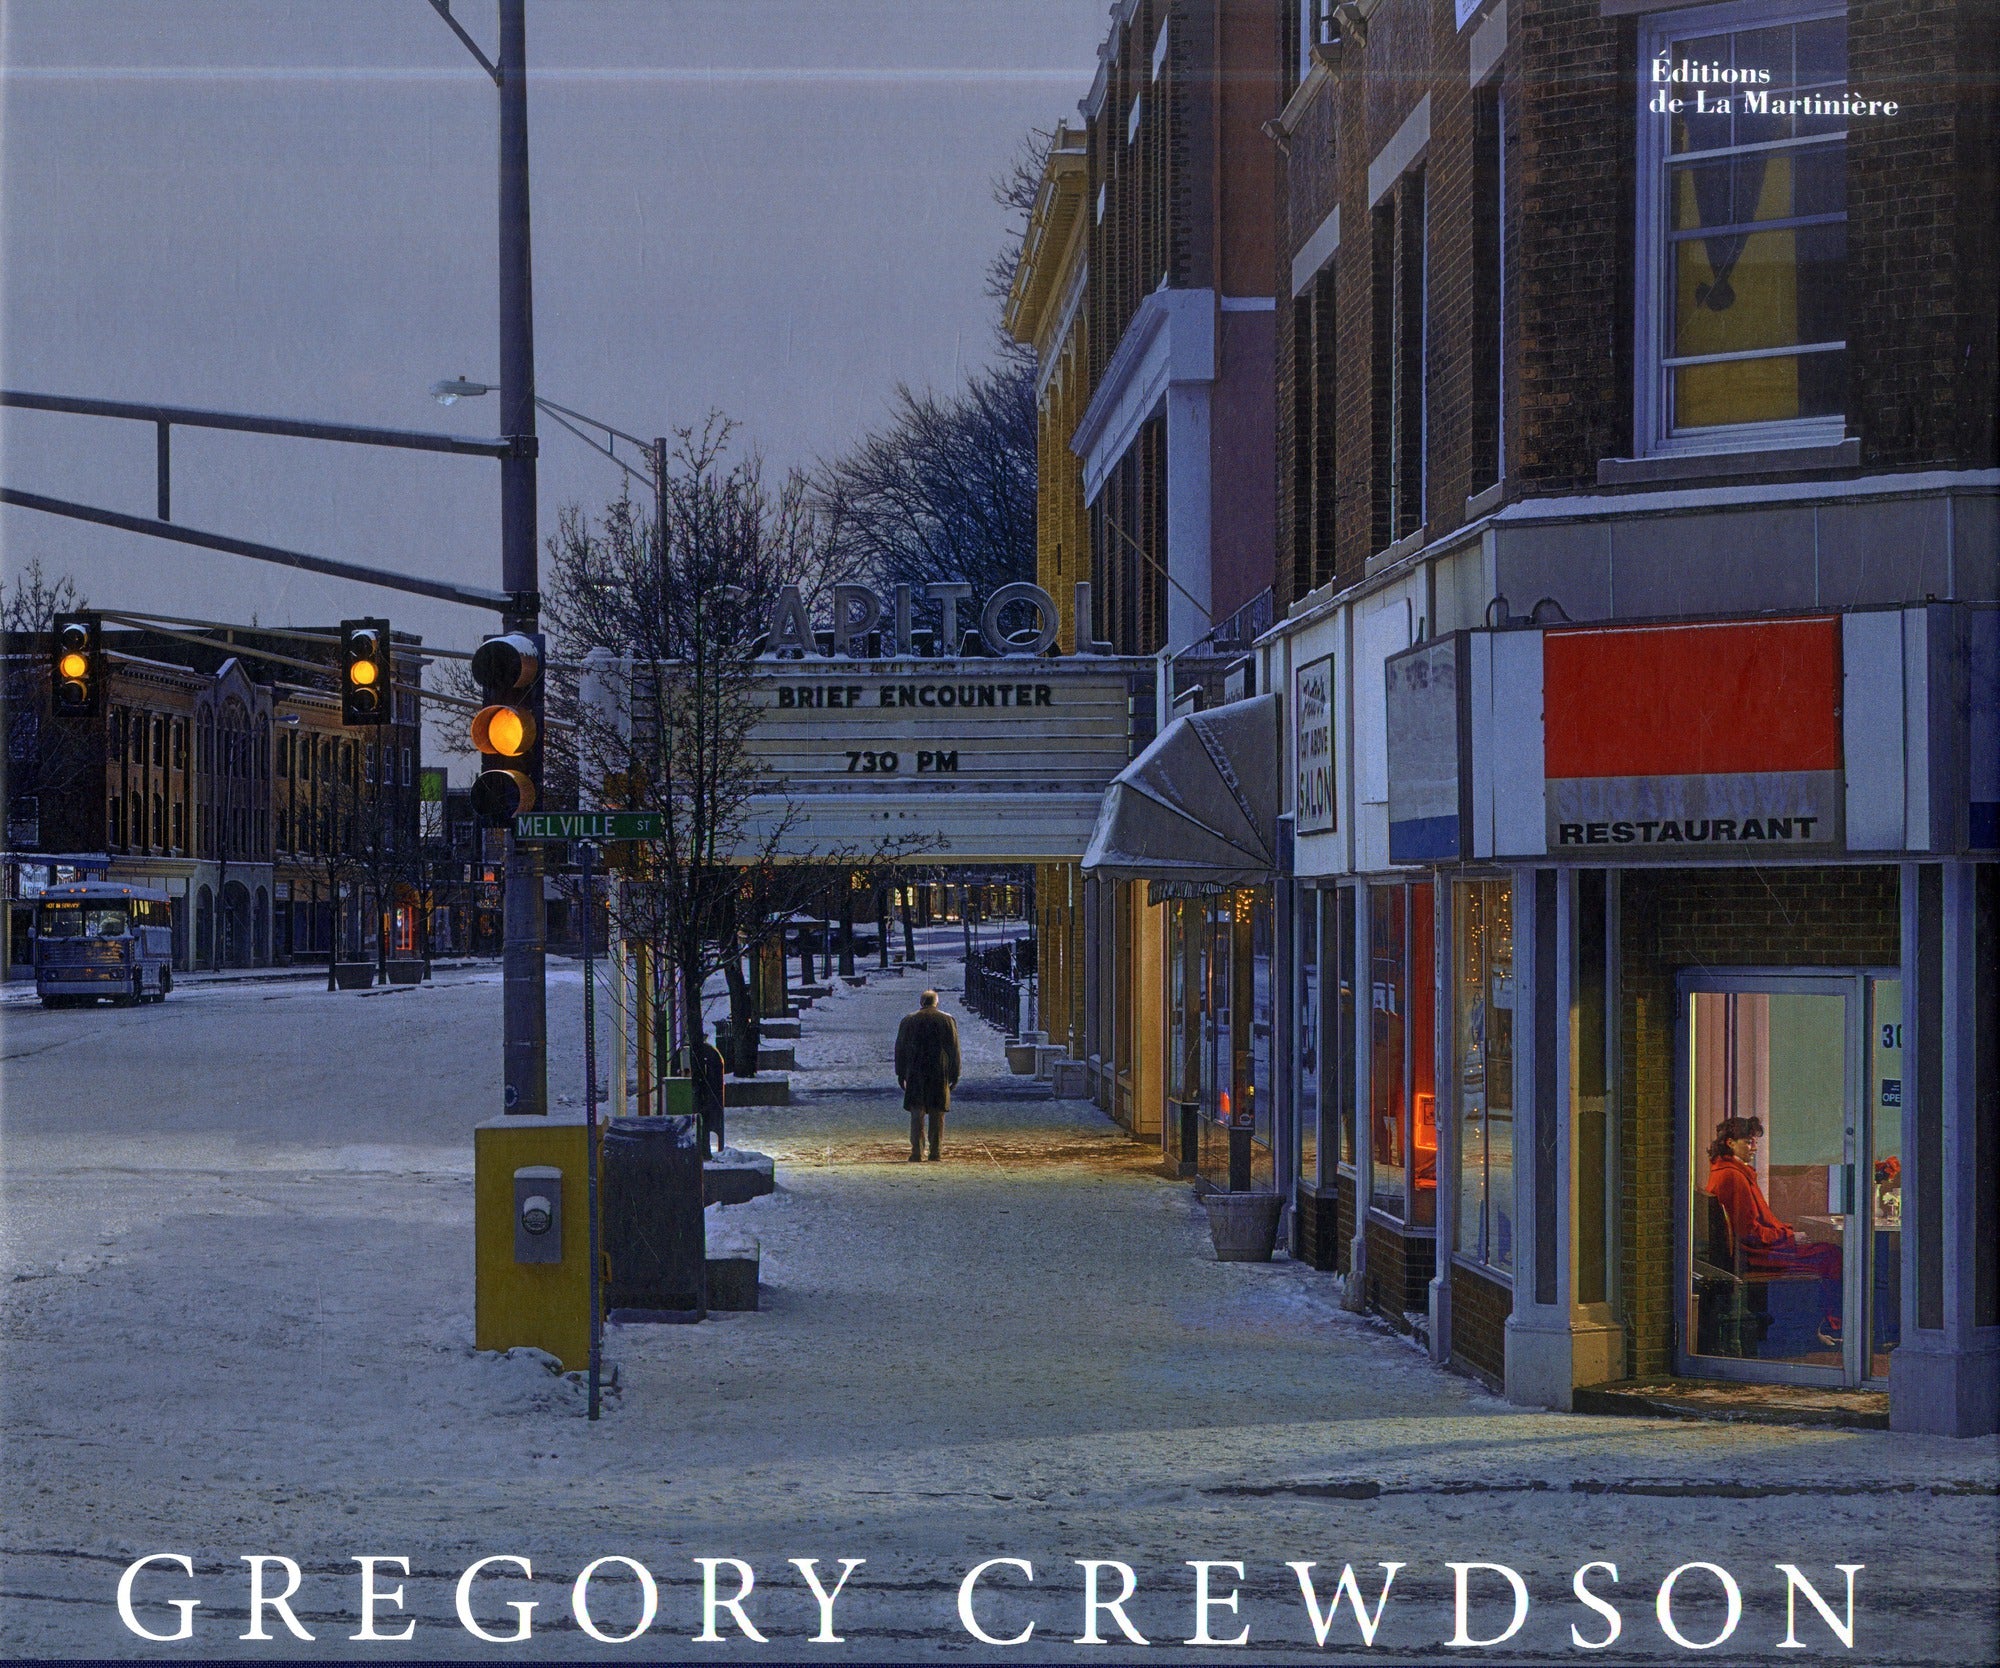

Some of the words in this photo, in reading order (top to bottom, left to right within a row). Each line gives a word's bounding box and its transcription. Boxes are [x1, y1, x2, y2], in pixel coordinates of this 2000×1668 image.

[778, 685, 863, 709] BRIEF
[880, 683, 1053, 708] ENCOUNTER
[845, 750, 899, 773] 730
[916, 750, 959, 773] PM
[1300, 766, 1332, 821] SALON
[1556, 775, 1686, 822] SUGAR
[518, 816, 616, 837] MELVILLE
[636, 819, 650, 831] ST
[1558, 816, 1819, 845] RESTAURANT
